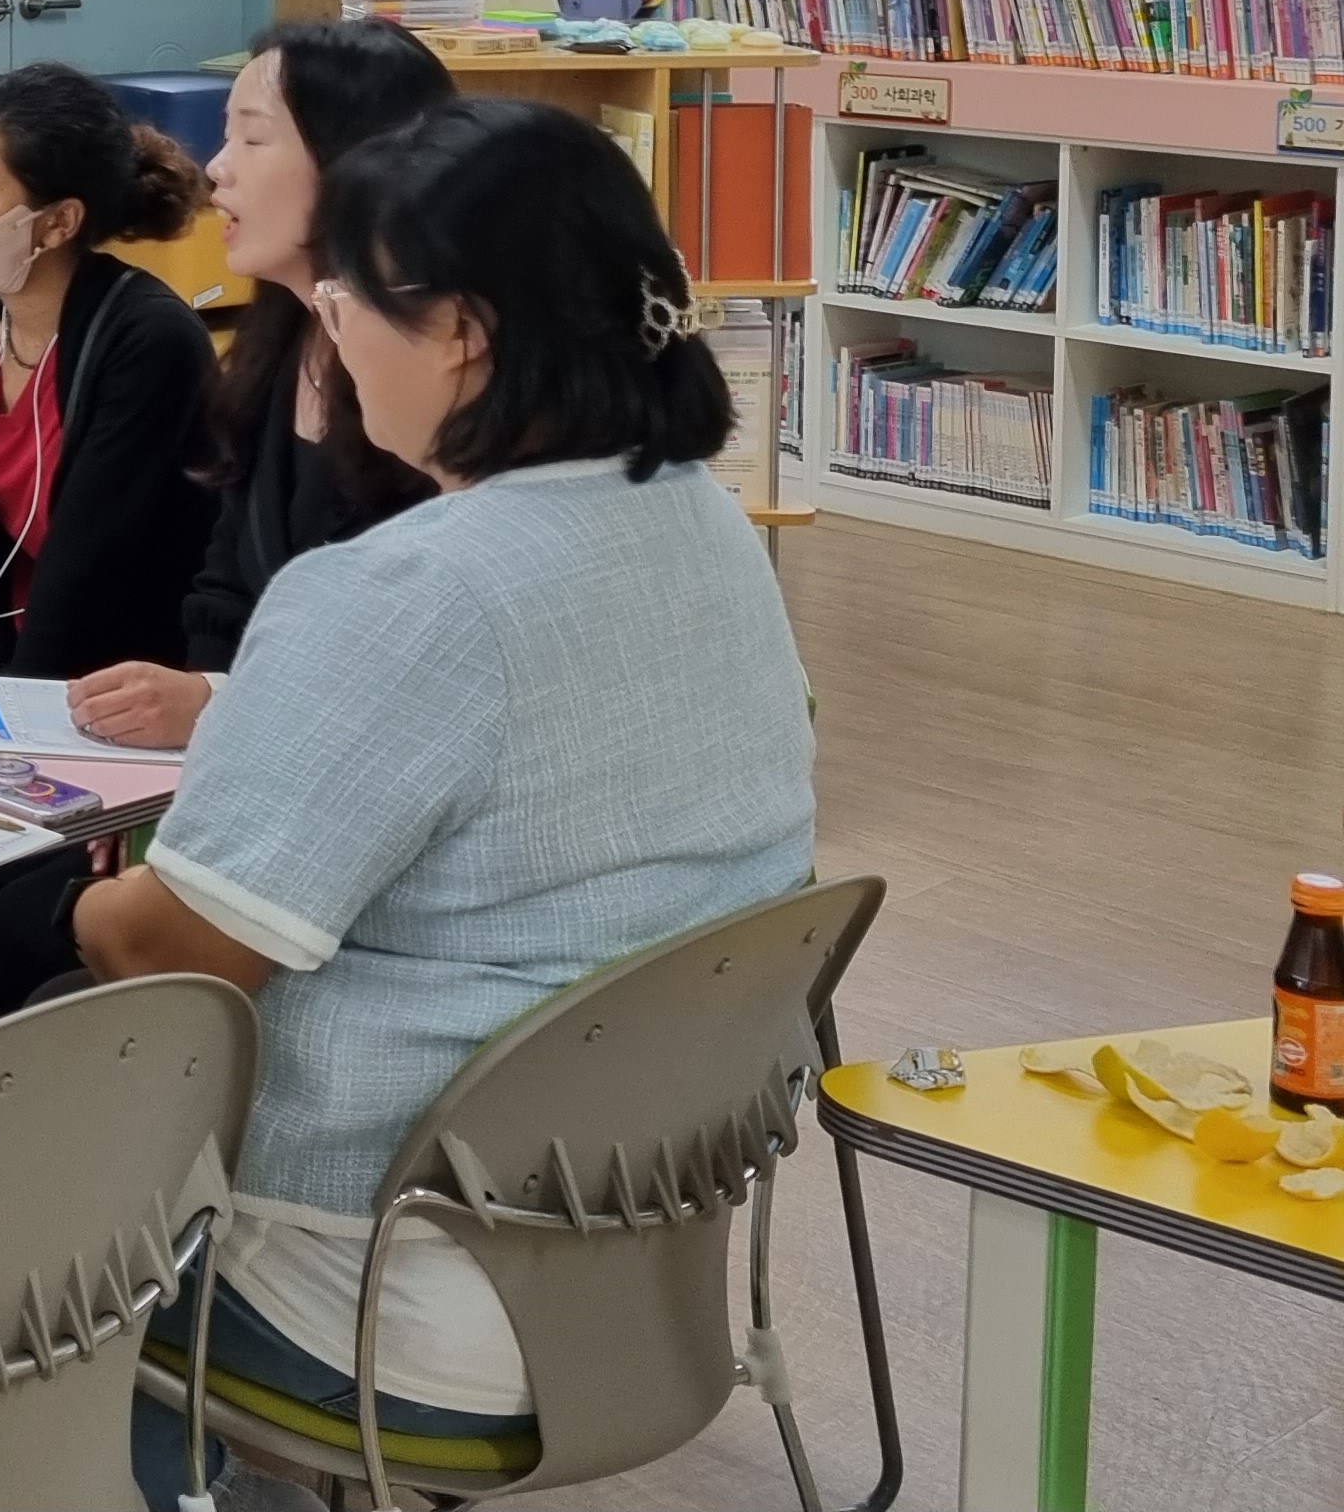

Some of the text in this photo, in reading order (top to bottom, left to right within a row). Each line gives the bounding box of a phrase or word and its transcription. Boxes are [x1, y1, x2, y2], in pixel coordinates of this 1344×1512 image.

[851, 86, 936, 105] 300 사회과학
[1293, 116, 1326, 133] 500
